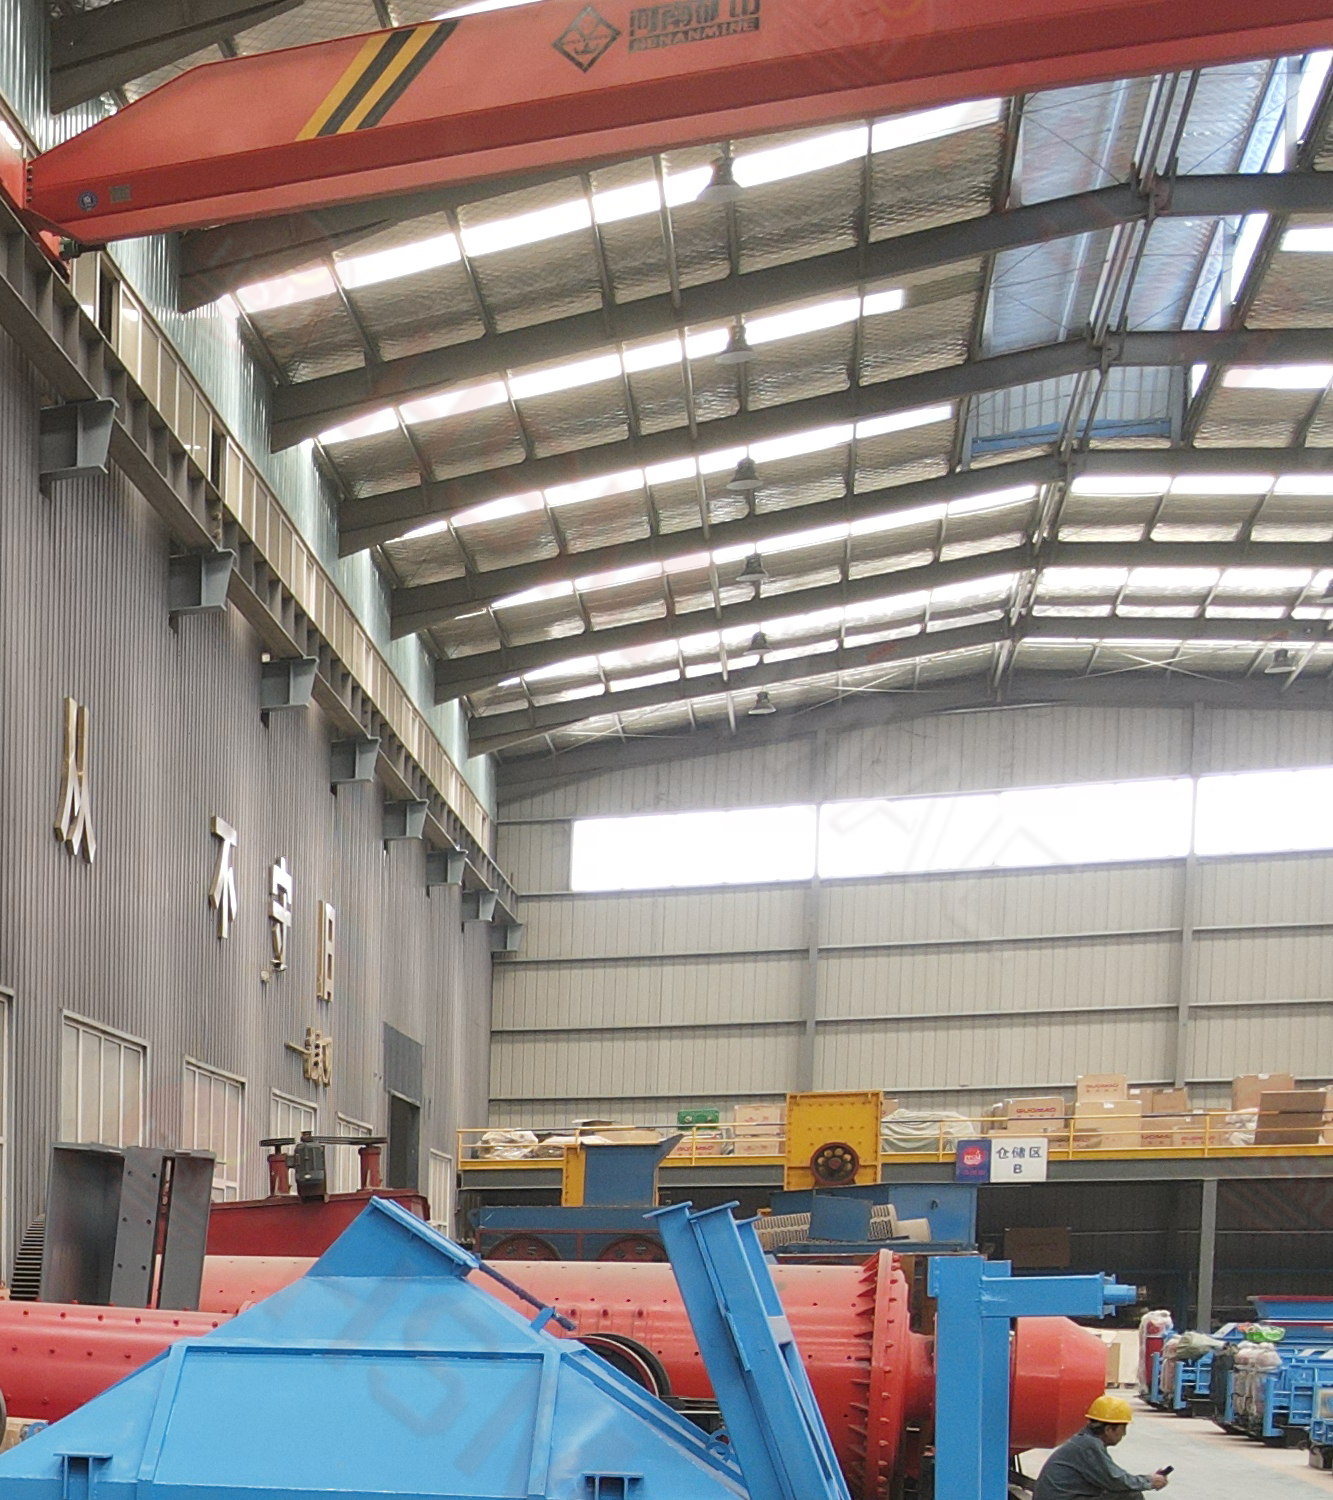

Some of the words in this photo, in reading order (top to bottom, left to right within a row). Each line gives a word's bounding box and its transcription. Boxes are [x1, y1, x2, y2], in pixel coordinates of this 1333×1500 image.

[995, 1147, 1042, 1160] 仓储区
[1013, 1163, 1023, 1174] B
